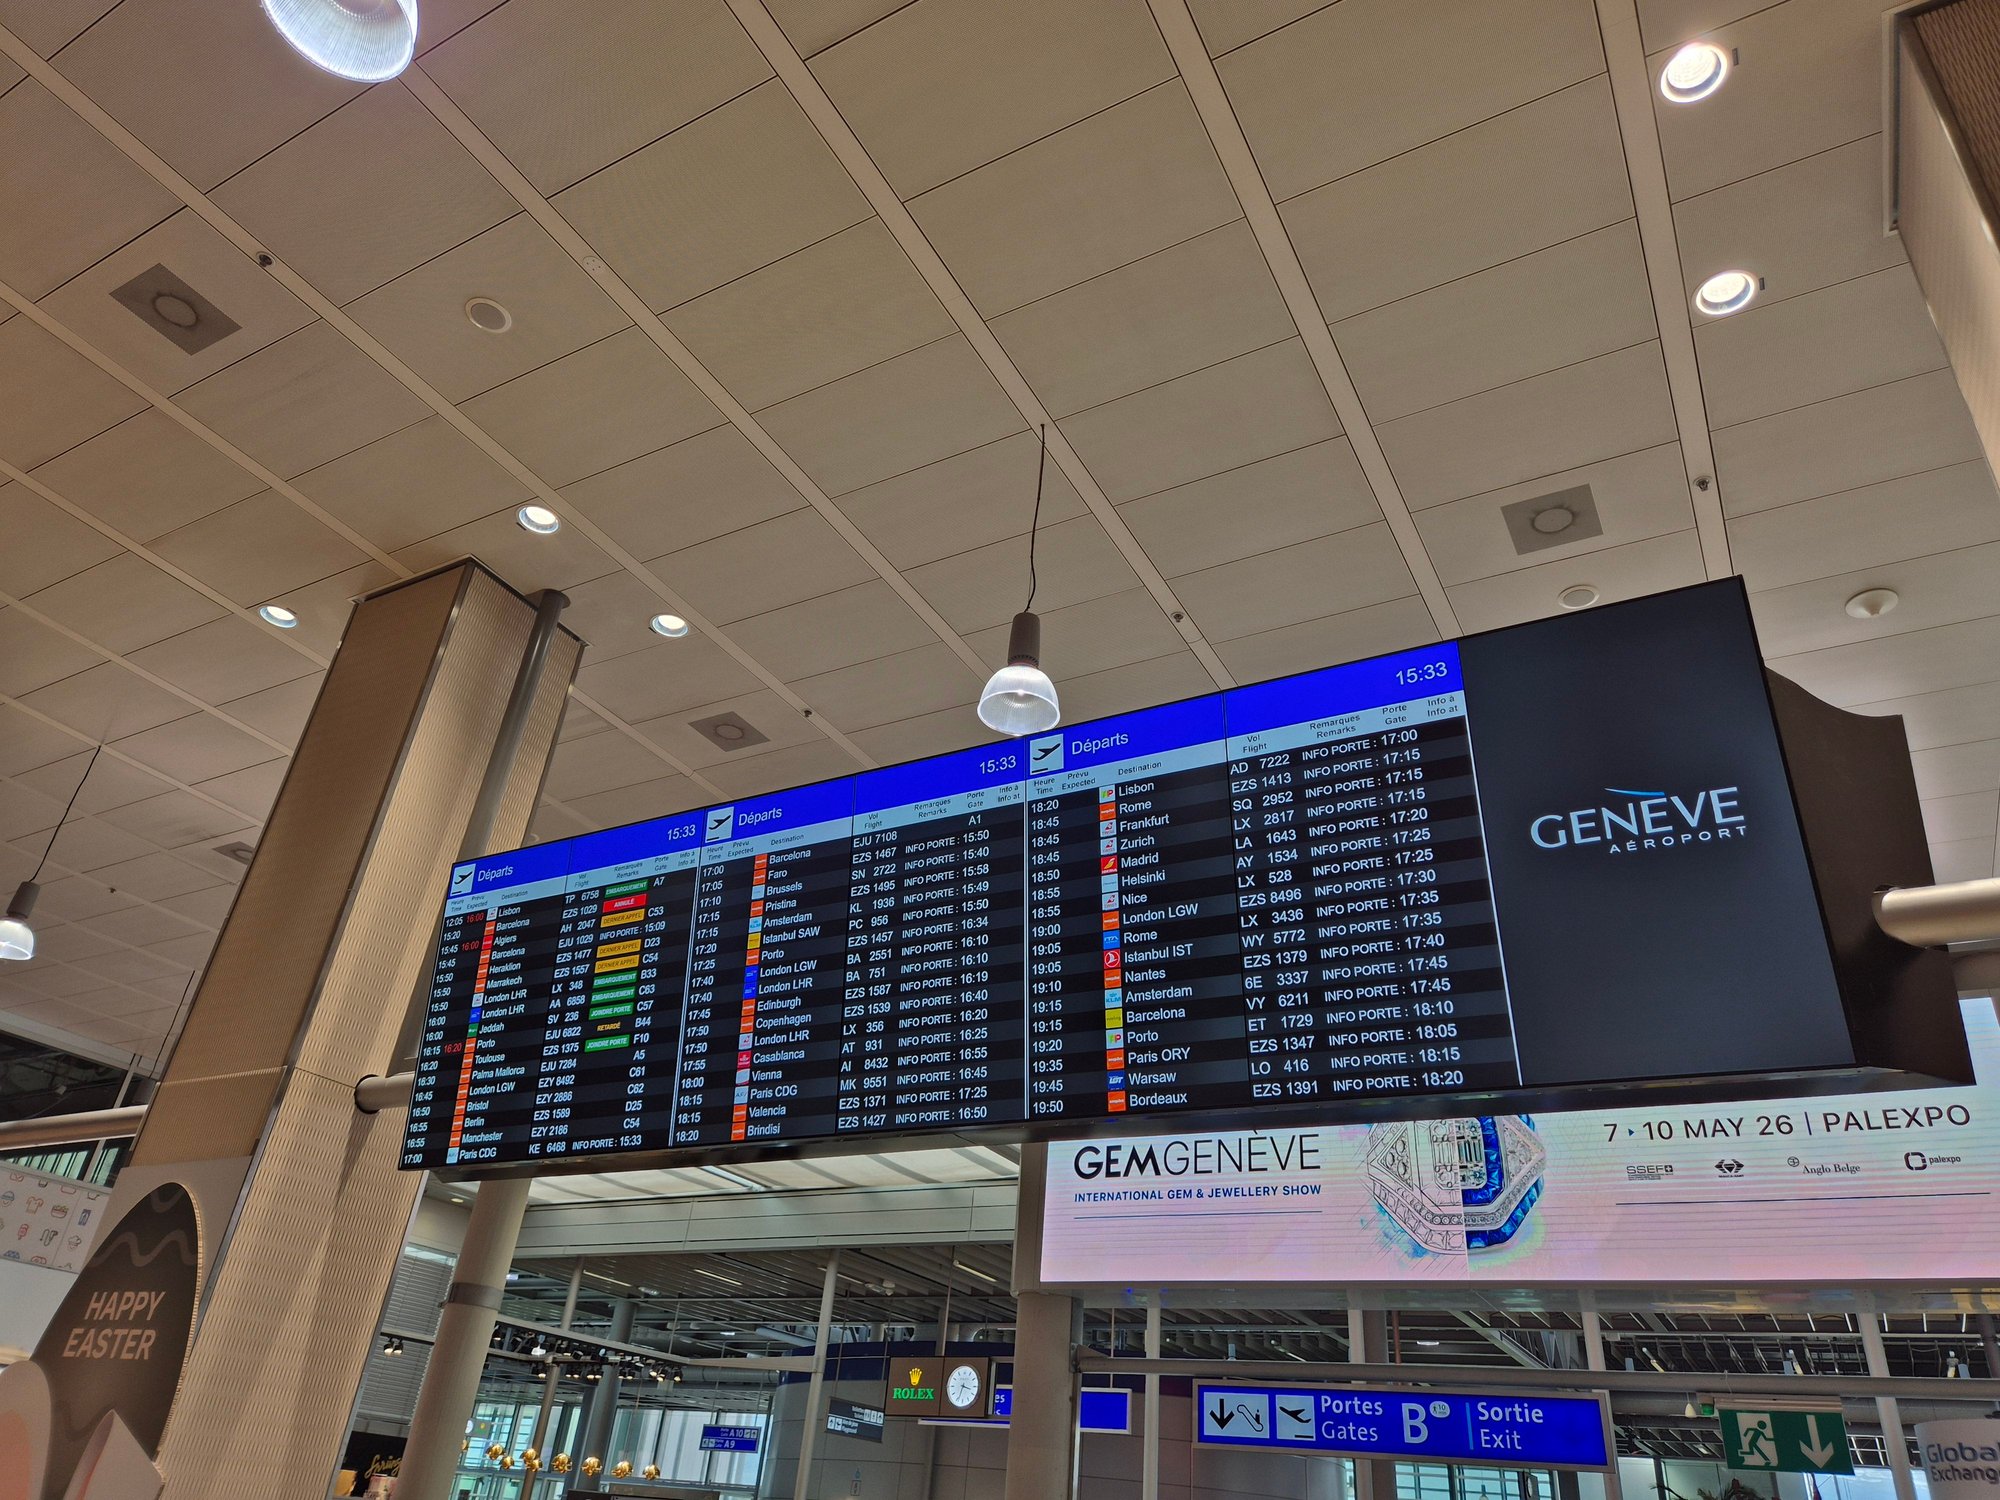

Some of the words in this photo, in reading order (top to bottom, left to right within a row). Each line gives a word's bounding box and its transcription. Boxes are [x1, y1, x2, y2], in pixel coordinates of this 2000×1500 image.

[1396, 662, 1447, 685] 15:33
[1427, 697, 1446, 707] Info
[1382, 705, 1407, 715] Porte
[1427, 708, 1446, 717] Info
[1449, 705, 1458, 713] at
[1310, 715, 1360, 731] Remarques
[1385, 716, 1407, 725] Gate
[1316, 723, 1356, 738] Remarks
[1072, 733, 1128, 755] Départs
[1247, 734, 1260, 743] Vol
[1302, 747, 1329, 761] INFO
[1331, 739, 1371, 755] PORTE
[1381, 729, 1418, 746] 17:00
[1243, 743, 1267, 753] Flight
[980, 755, 1016, 774] 15:33
[1118, 762, 1161, 776] Destination
[1230, 762, 1248, 775] AD
[1259, 754, 1290, 769] 7222
[1034, 778, 1055, 787] Heure
[1067, 771, 1089, 780] Prévu
[1231, 778, 1257, 793] EZS
[1262, 772, 1291, 787] 1413
[1036, 787, 1053, 795] Time
[1062, 778, 1095, 790] Expected
[1119, 782, 1154, 796] Lisbon
[1031, 799, 1059, 813] 18:20
[1119, 801, 1152, 814] Rome
[738, 808, 782, 826] Départs
[968, 814, 981, 826] A1
[1120, 814, 1170, 832] Frankfurt
[1530, 786, 1745, 849] GENÈVE
[668, 824, 696, 840] 15:33
[1120, 835, 1155, 850] Zurich
[1609, 825, 1747, 854] AÉROPORT
[769, 850, 811, 864] Barcelona
[1032, 851, 1060, 865] 18:45
[1121, 852, 1159, 868] Madrid
[477, 865, 513, 882] Départs
[768, 870, 788, 880] Faro
[1032, 869, 1060, 883] 18:50
[1122, 869, 1165, 887] Helsinki
[653, 876, 665, 887] A7
[766, 881, 803, 896] Brussels
[1122, 893, 1147, 905] Nice
[1239, 893, 1266, 908] EZS
[1270, 888, 1302, 903] 8496
[498, 907, 521, 917] Lisbon
[648, 906, 664, 917] C53
[765, 899, 797, 912] Pristina
[1032, 905, 1061, 919] 18:55
[763, 913, 812, 928] Amsterdam
[1123, 910, 1165, 924] London
[1168, 903, 1198, 918] LGW
[446, 916, 463, 927] 12:05
[496, 919, 530, 931] Barcelona
[763, 930, 796, 944] Istanbul
[798, 925, 821, 938] SAW
[1032, 923, 1061, 937] 19:00
[493, 935, 517, 947] Algiers
[644, 937, 660, 948] D23
[1124, 931, 1158, 944] Rome
[1241, 934, 1264, 948] WY
[1273, 929, 1306, 944] 5772
[642, 952, 659, 963] C54
[761, 949, 784, 961] Porto
[1124, 946, 1169, 963] Istanbul
[1173, 943, 1193, 957] IST
[489, 962, 521, 974] Heraklion
[640, 968, 657, 979] B33
[760, 965, 792, 977] London
[794, 960, 817, 972] LGW
[1032, 961, 1061, 975] 19:05
[486, 975, 523, 989] Marrakech
[1125, 969, 1166, 983] Nantes
[1245, 976, 1263, 989] 6E
[1277, 970, 1309, 986] 3337
[638, 984, 655, 995] C63
[758, 982, 791, 994] London
[793, 977, 813, 989] LHR
[1032, 980, 1062, 994] 19:10
[1125, 986, 1192, 1003] Amsterdam
[637, 1000, 654, 1011] C57
[757, 996, 801, 1011] Edinburgh
[756, 1014, 812, 1030] Copenhagen
[1126, 1008, 1186, 1023] Barcelona
[479, 1022, 505, 1034] Jeddah
[1033, 1019, 1062, 1033] 19:15
[633, 1032, 649, 1044] F10
[754, 1033, 787, 1046] London
[789, 1029, 809, 1042] LHR
[1127, 1030, 1159, 1043] Porto
[476, 1039, 496, 1049] Porto
[1033, 1039, 1062, 1053] 19:20
[475, 1054, 505, 1064] Toulouse
[753, 1050, 805, 1064] Casablanca
[1128, 1050, 1158, 1064] Paris
[1161, 1047, 1190, 1061] ORY
[471, 1070, 494, 1080] Palma
[495, 1066, 525, 1077] Mallorca
[1033, 1059, 1063, 1073] 19:35
[752, 1070, 782, 1081] Vienna
[1128, 1072, 1176, 1085] Warsaw
[1333, 1079, 1363, 1092] INFO
[1366, 1075, 1410, 1089] PORTE
[1422, 1070, 1463, 1086] 18:20
[750, 1087, 773, 1100] Paris
[775, 1084, 798, 1097] CDG
[1253, 1083, 1282, 1097] EZS
[1286, 1080, 1318, 1095] 1391
[466, 1100, 489, 1112] Bristol
[1130, 1092, 1188, 1107] Bordeaux
[749, 1104, 786, 1118] Valencia
[1033, 1100, 1063, 1114] 19:50
[464, 1116, 485, 1128] Berlin
[1604, 1123, 1617, 1142] 7
[1643, 1120, 1673, 1140] 10
[1683, 1117, 1744, 1139] MAY
[1756, 1115, 1793, 1136] 26
[1823, 1105, 1970, 1132] PALEXPO
[747, 1123, 780, 1136] Brindisi
[461, 1131, 503, 1144] Manchester
[459, 1149, 478, 1160] Paris
[478, 1147, 497, 1158] CDG
[1074, 1130, 1321, 1179] GEMGENÈVE
[1929, 1155, 1961, 1165] palexpo
[1626, 1165, 1664, 1175] SSEF
[1802, 1164, 1831, 1176] Anglo
[1833, 1163, 1861, 1174] Belge
[1074, 1190, 1164, 1202] INTERNATIONAL
[1167, 1189, 1192, 1199] GEM
[1196, 1188, 1204, 1199] &
[1207, 1186, 1278, 1198] JEWELLERY
[1283, 1184, 1321, 1196] SHOW
[84, 1291, 166, 1321] HAPPY
[62, 1328, 156, 1360] EASTER
[892, 1388, 934, 1399] ROLEX
[1321, 1395, 1383, 1415] Portes
[1477, 1402, 1543, 1423] Sortie
[1401, 1403, 1428, 1444] B
[1322, 1421, 1378, 1441] Gates
[1480, 1429, 1522, 1450] Exit
[1930, 1465, 2000, 1484] Exchang
